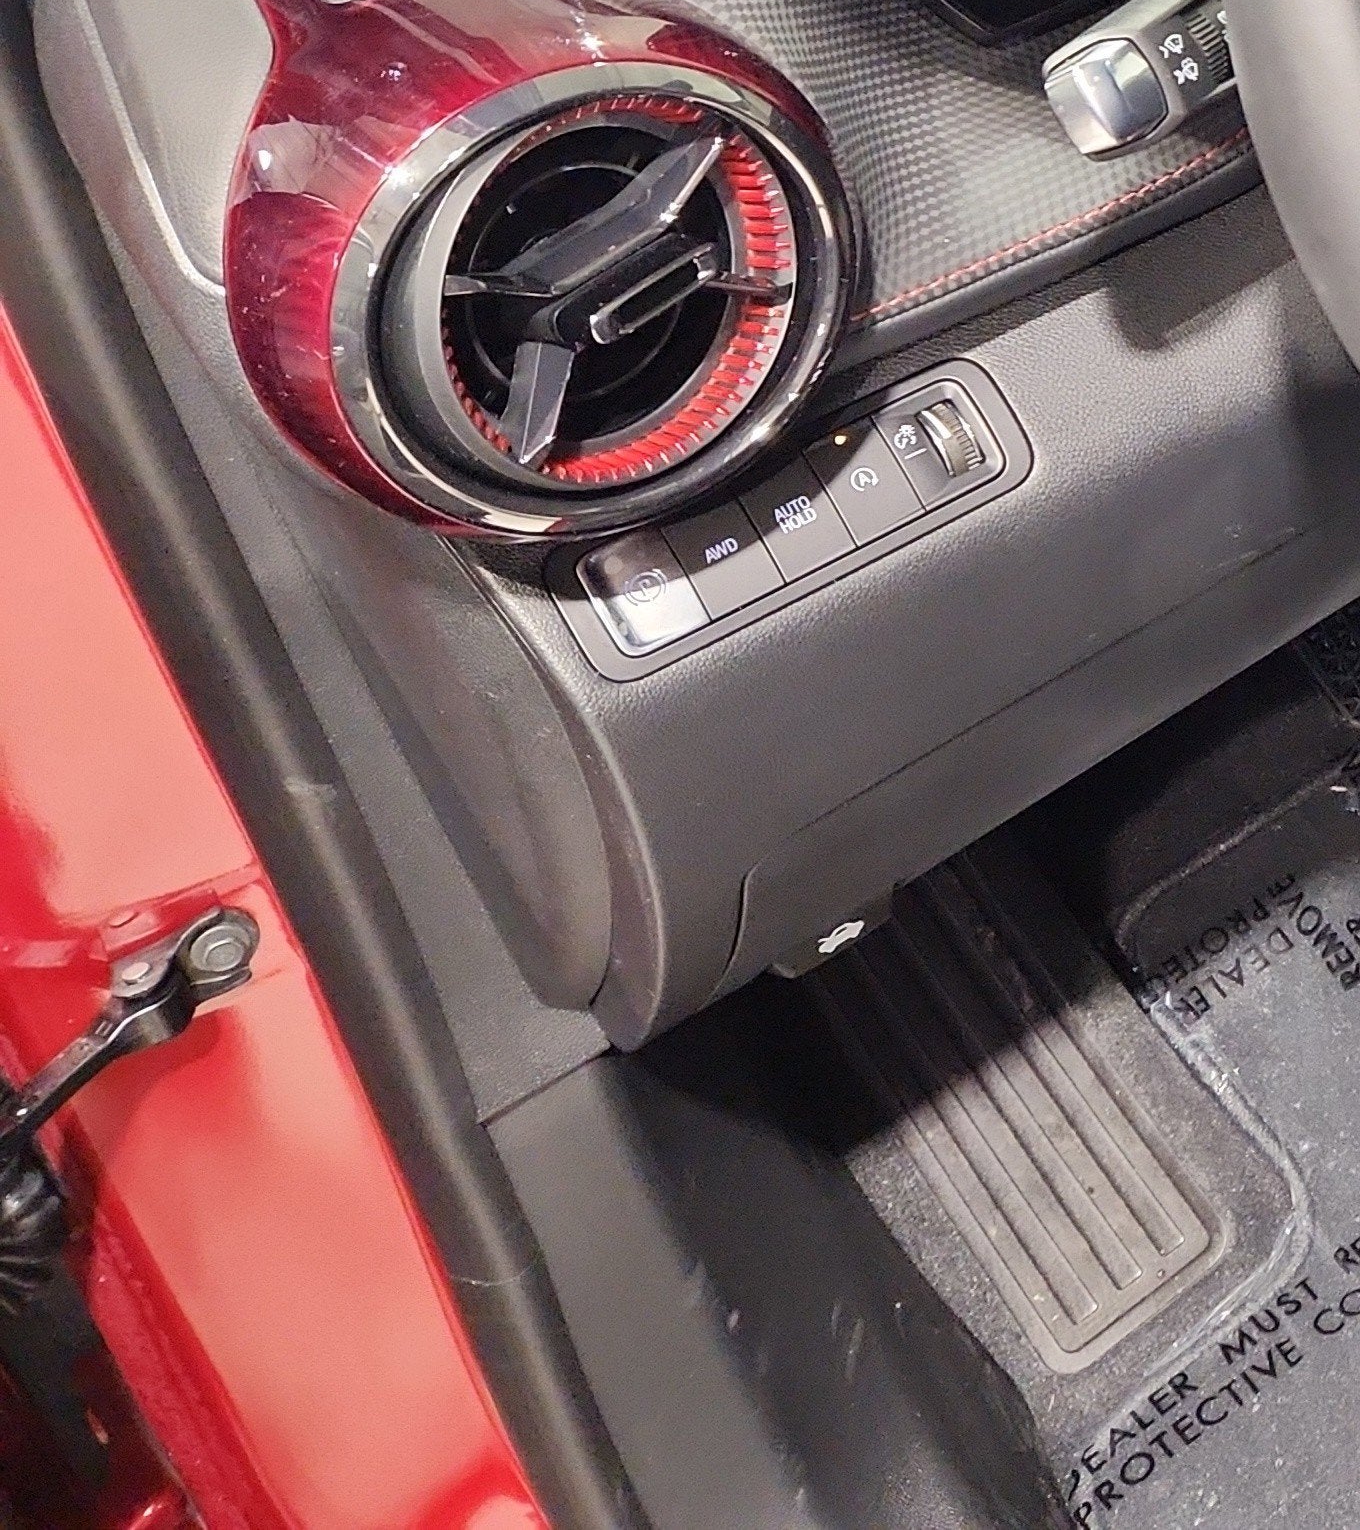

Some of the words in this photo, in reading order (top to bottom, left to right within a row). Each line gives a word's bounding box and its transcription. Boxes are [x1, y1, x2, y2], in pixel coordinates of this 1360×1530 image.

[772, 495, 811, 523] AUTO
[778, 507, 818, 535] HOLD
[703, 536, 739, 564] AWD
[1218, 1277, 1319, 1366] MUST
[1073, 1338, 1304, 1530] PROTECTIVE
